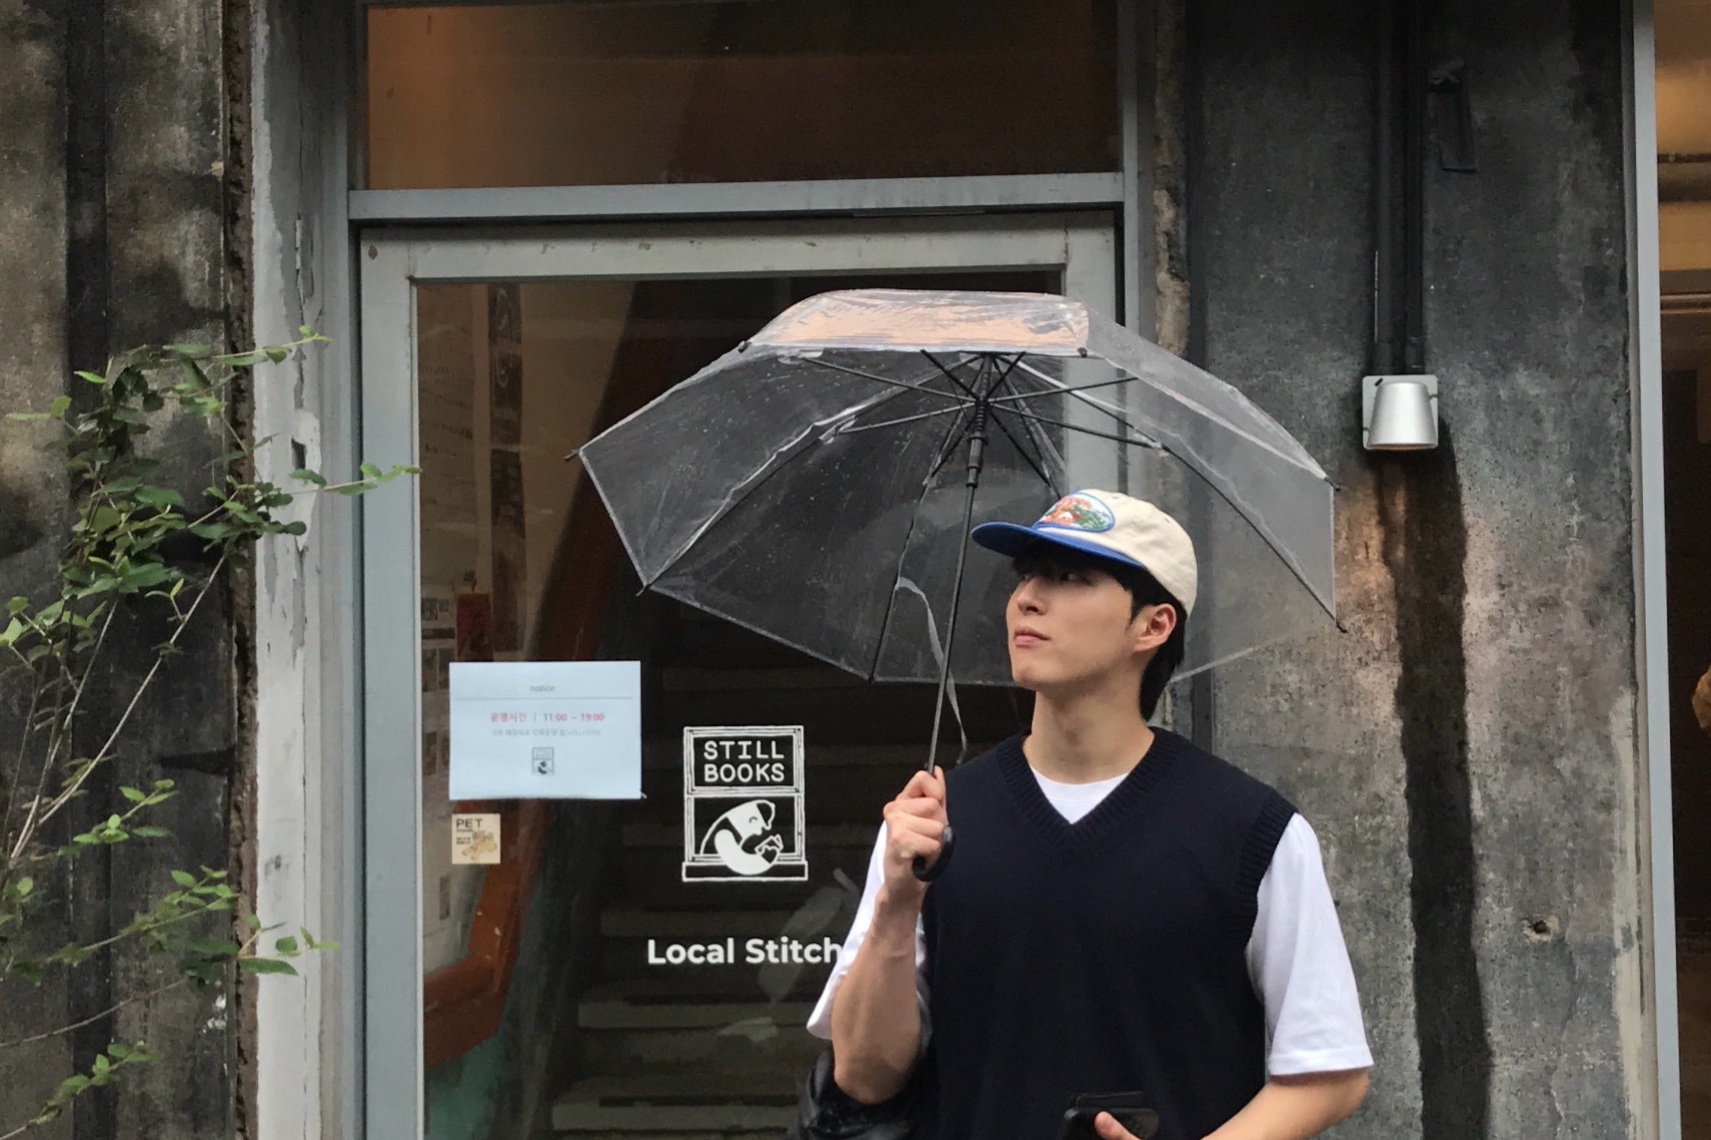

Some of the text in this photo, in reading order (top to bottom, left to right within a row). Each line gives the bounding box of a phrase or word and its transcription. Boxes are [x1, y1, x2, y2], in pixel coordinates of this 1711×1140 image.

[543, 713, 567, 722] 11:00
[581, 713, 605, 722] 19:00
[704, 740, 785, 760] STILL
[704, 763, 785, 783] BOOKS
[456, 818, 483, 828] PET
[648, 936, 843, 964] Local Stitch
